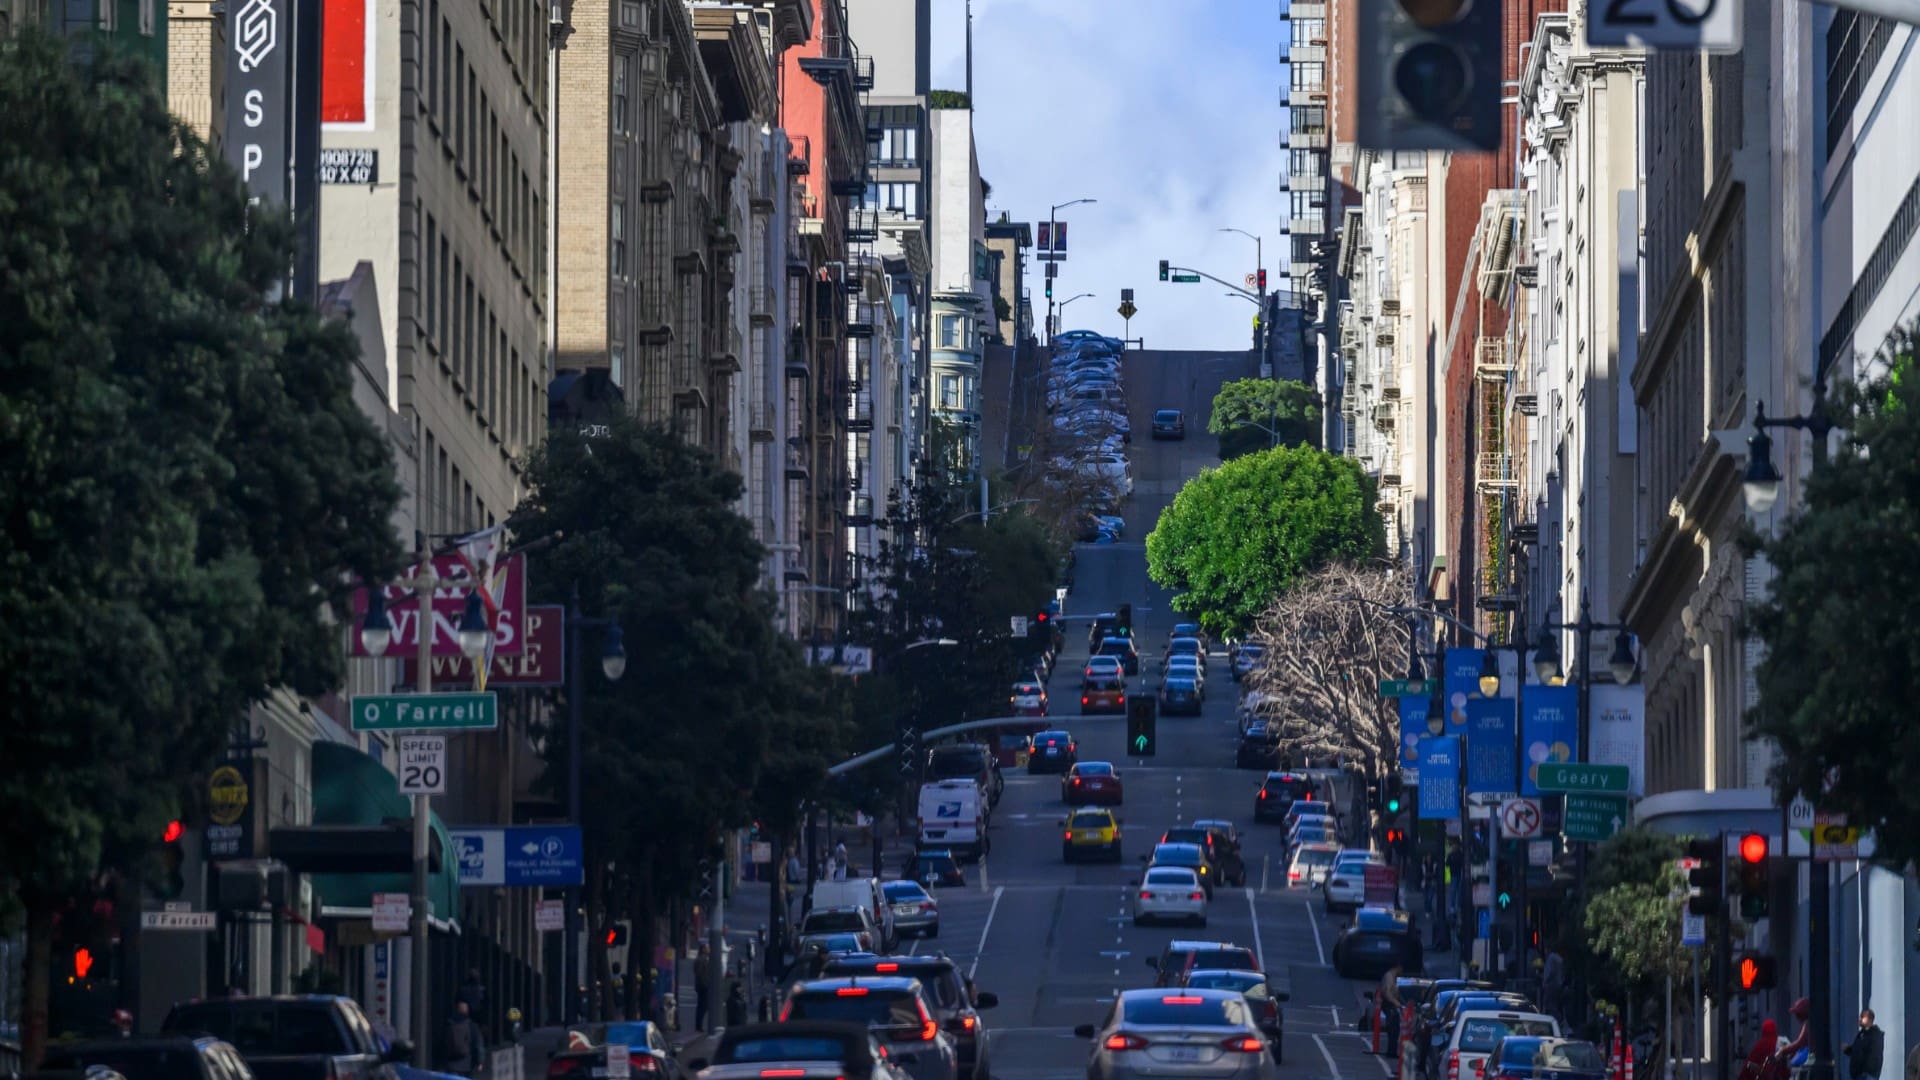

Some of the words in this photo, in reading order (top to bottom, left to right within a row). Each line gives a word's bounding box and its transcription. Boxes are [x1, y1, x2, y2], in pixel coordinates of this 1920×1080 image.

[364, 702, 484, 723] O'Farrell
[403, 741, 443, 751] SPEED
[407, 753, 437, 763] LIMIT
[404, 766, 441, 788] 20
[1557, 769, 1609, 787] Geary
[1482, 792, 1496, 801] ONE
